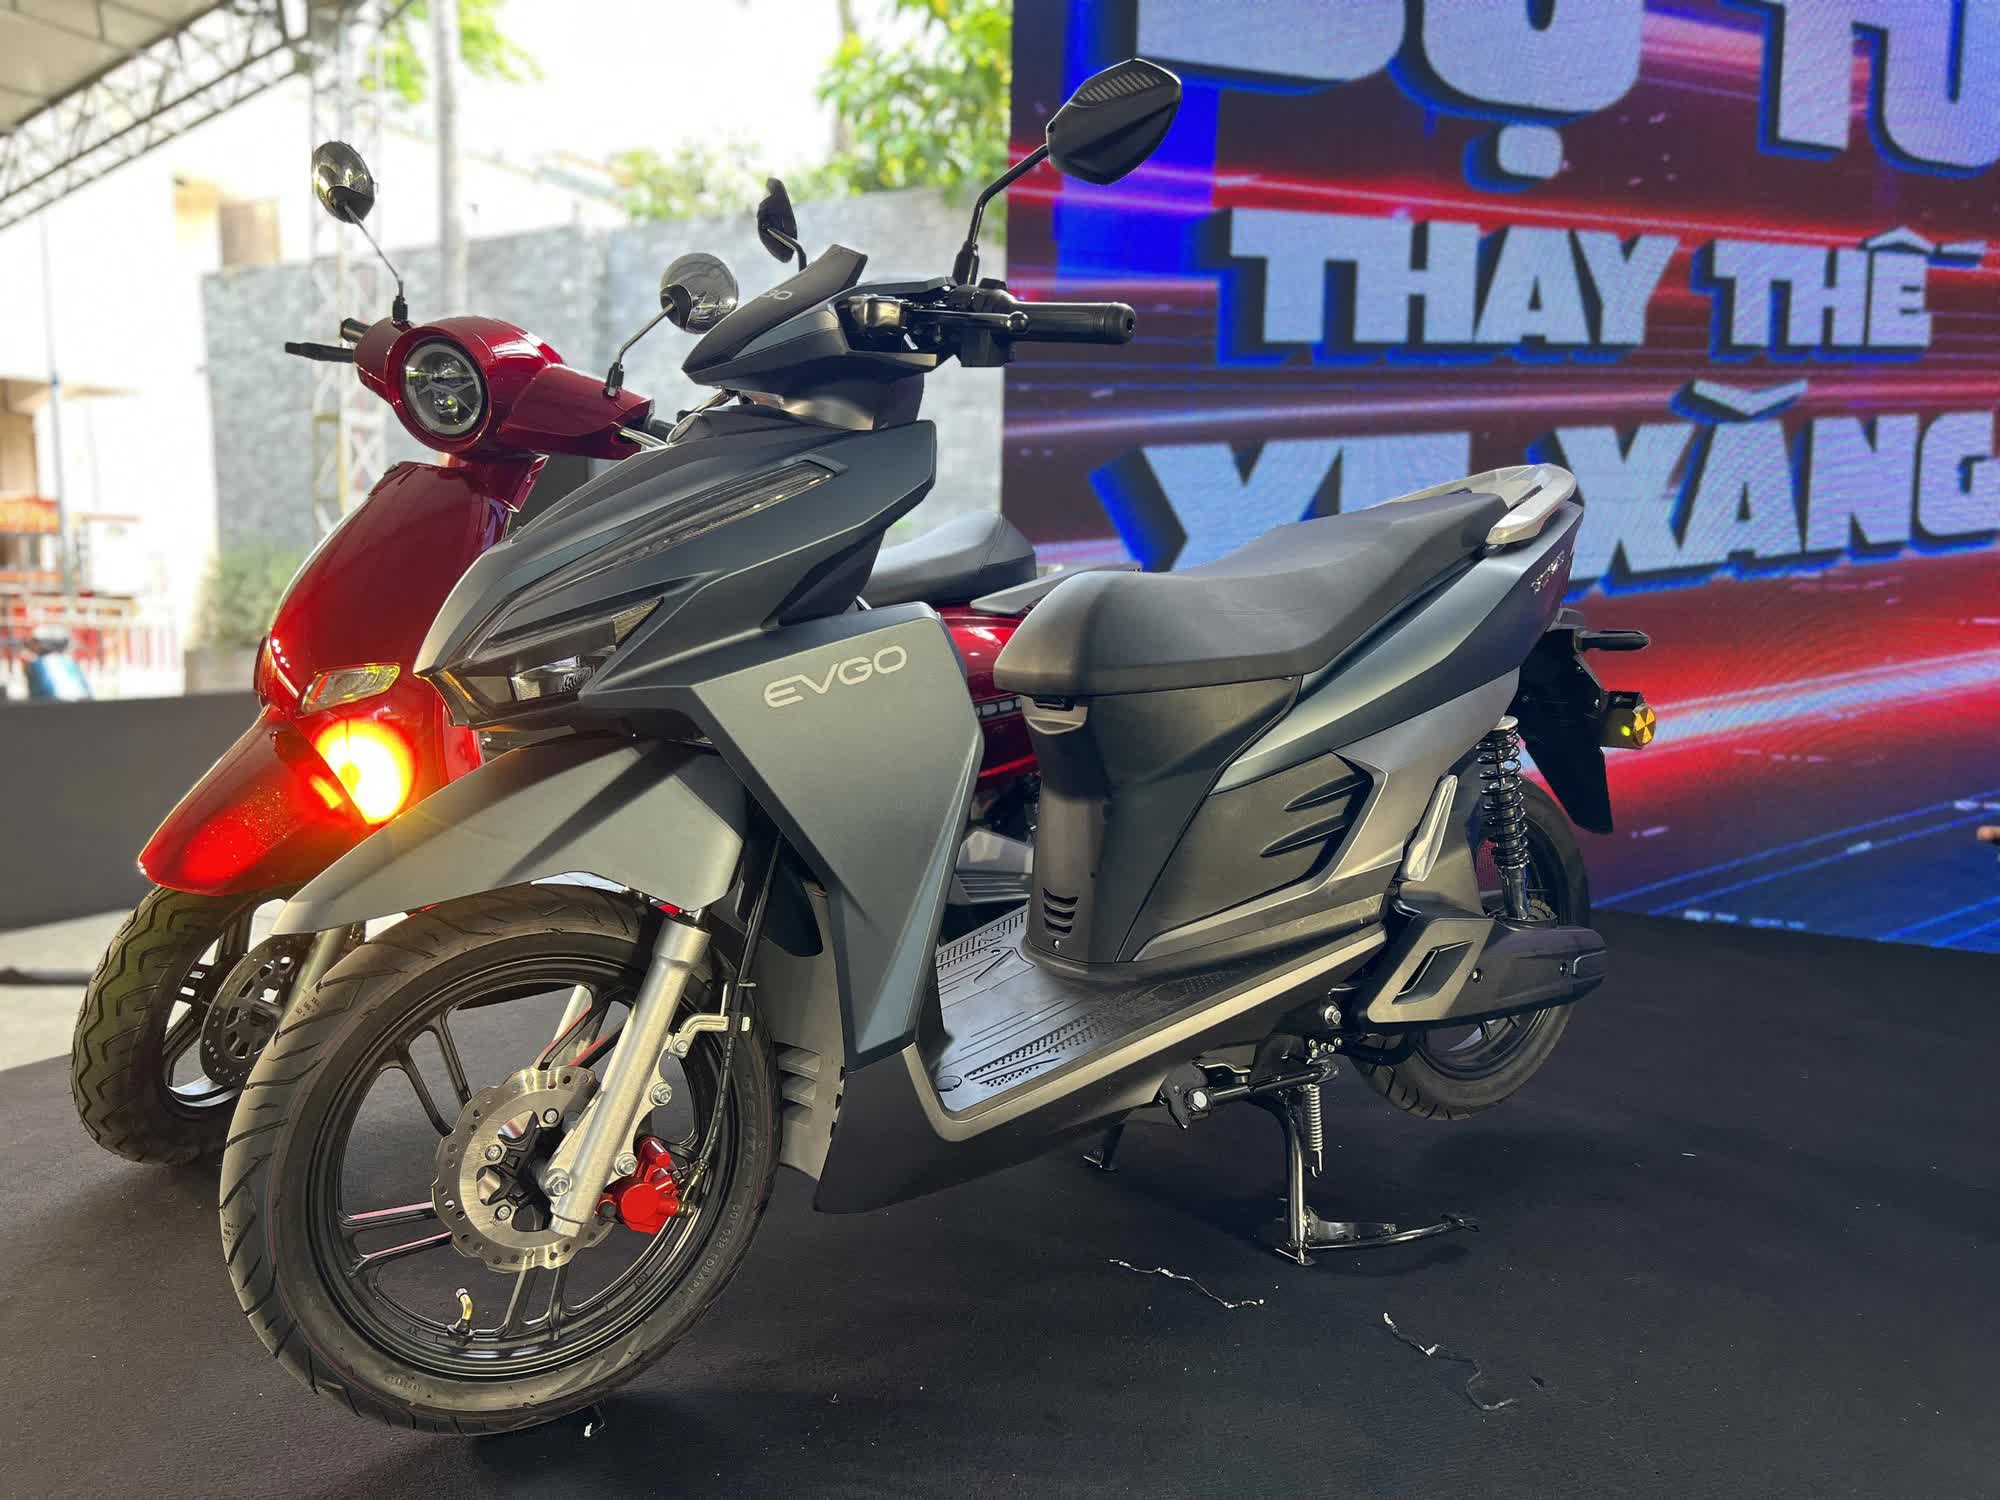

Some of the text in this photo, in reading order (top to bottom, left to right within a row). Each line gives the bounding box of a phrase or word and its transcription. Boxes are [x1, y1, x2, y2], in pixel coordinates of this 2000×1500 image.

[1230, 207, 1986, 347] THAY THẾ
[1555, 380, 2000, 582] XĂNG
[764, 645, 908, 708] EVGO
